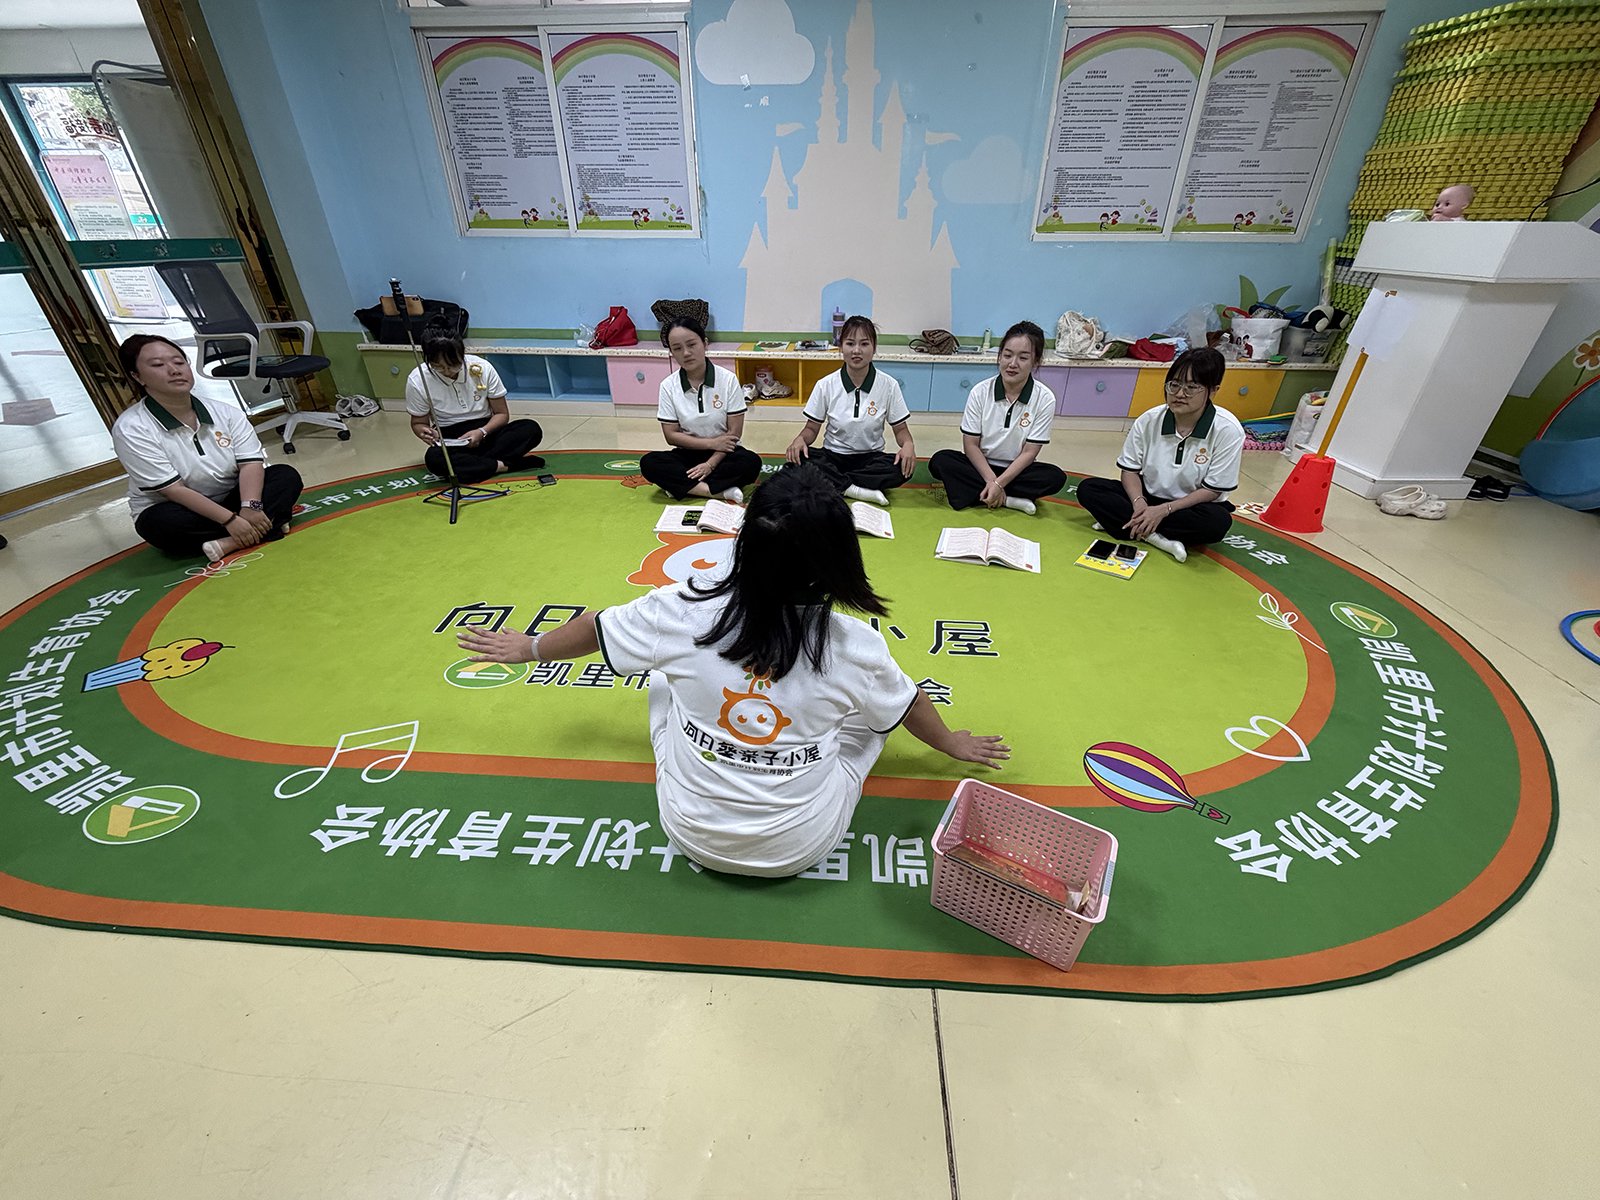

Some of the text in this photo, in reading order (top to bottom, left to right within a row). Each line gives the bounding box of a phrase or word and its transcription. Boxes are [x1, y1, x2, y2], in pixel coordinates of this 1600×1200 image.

[0, 588, 141, 815] 凯里市计划生育协会
[683, 720, 822, 767] 向日葵亲子小屋
[1214, 636, 1448, 883] 凯里市计划生育协会
